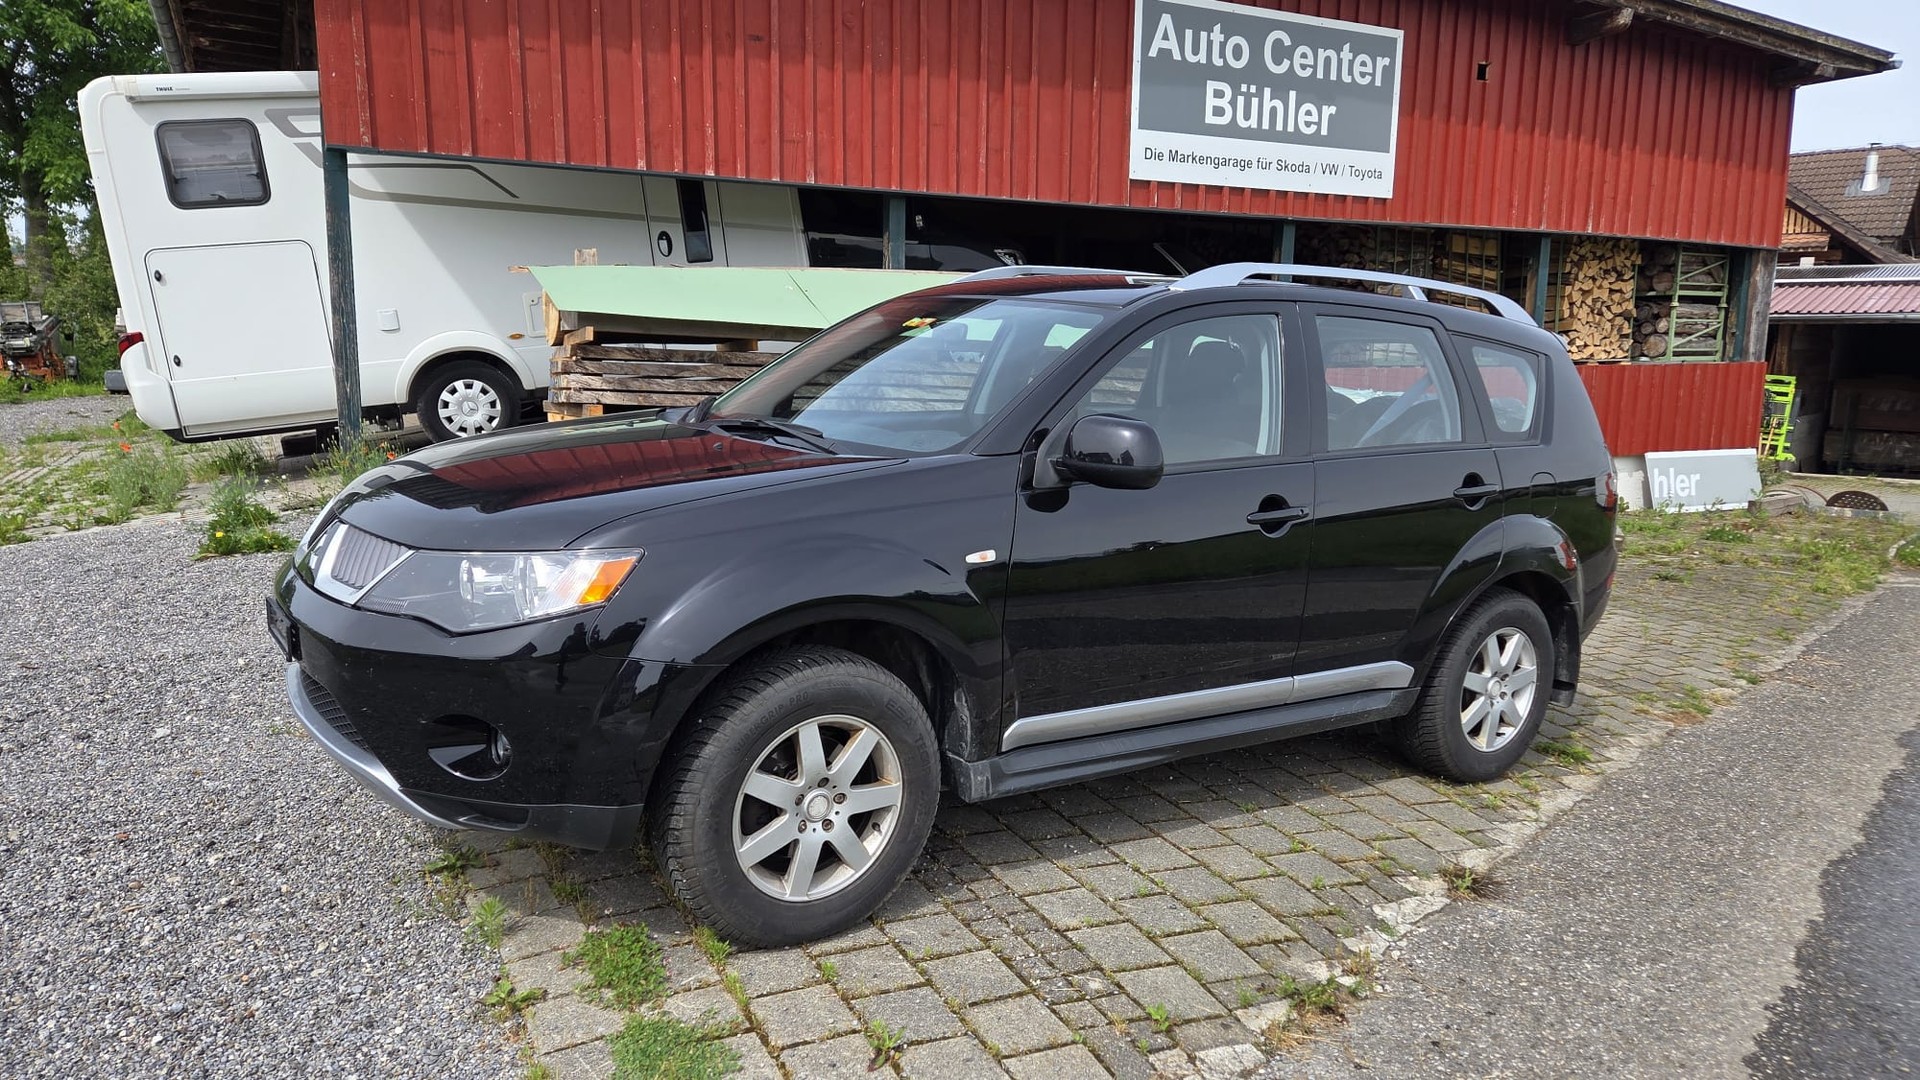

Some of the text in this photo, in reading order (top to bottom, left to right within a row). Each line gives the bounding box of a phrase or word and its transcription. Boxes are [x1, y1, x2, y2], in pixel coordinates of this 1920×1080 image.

[1148, 13, 1391, 87] Auto Center
[1204, 80, 1337, 136] Bühler
[1144, 147, 1164, 162] Die
[1168, 149, 1253, 172] Markengarage
[1256, 156, 1273, 171] für
[1276, 159, 1311, 174] Skoda
[1320, 163, 1339, 176] VW
[1348, 165, 1383, 181] Toyota
[1653, 467, 1701, 498] hler
